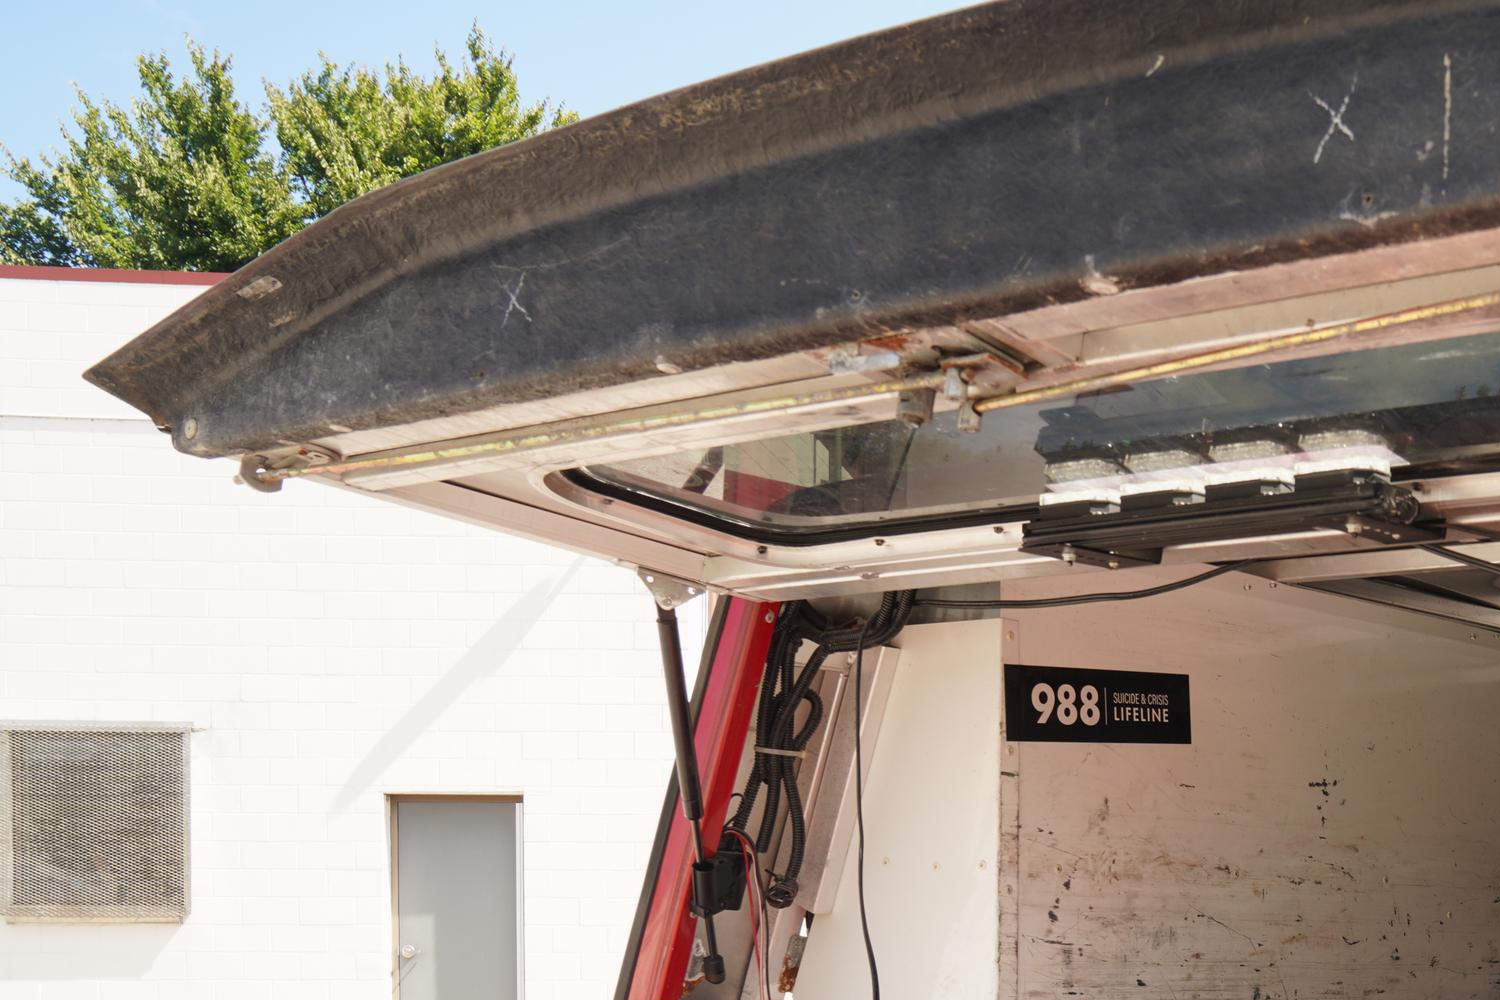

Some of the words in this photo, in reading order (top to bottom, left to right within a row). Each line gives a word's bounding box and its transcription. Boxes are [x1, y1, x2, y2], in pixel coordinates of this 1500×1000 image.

[1031, 682, 1100, 726] 988
[1113, 692, 1140, 705] SUICIDE
[1141, 693, 1147, 705] &
[1147, 694, 1169, 706] CRISIS
[1114, 706, 1169, 723] LIFELINE
